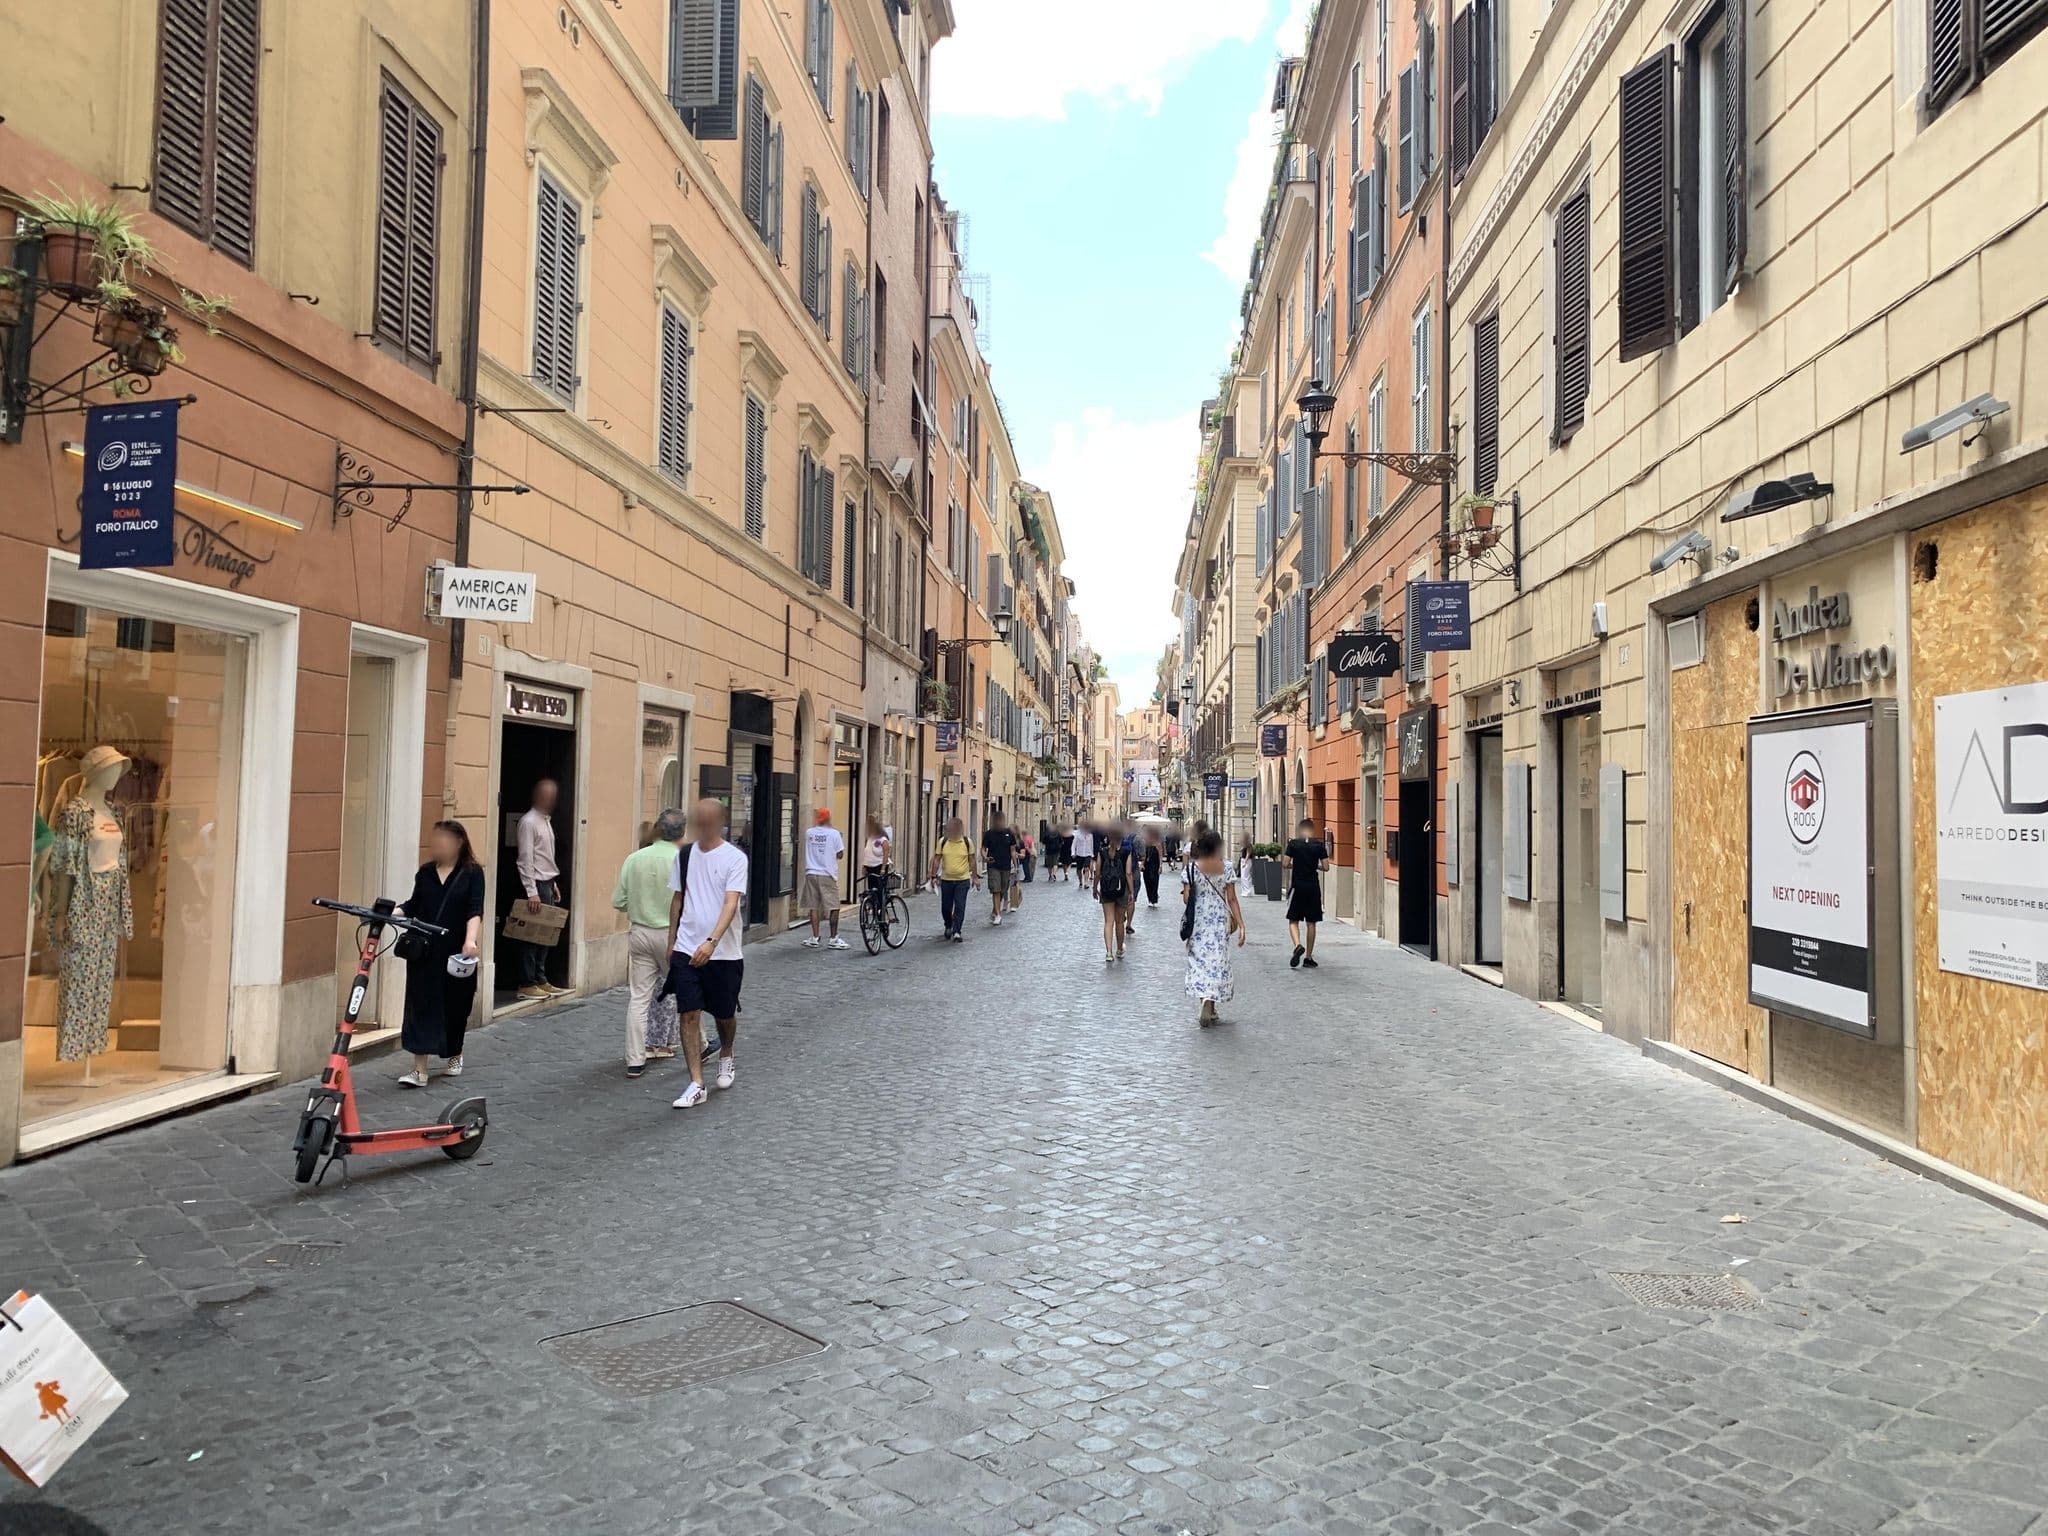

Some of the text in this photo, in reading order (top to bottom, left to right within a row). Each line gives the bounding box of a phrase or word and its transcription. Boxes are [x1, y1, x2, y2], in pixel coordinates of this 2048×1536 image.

[122, 480, 152, 490] LUGLIO
[112, 508, 142, 519] ROMA
[96, 520, 159, 533] FORO ITALICO
[183, 521, 256, 590] Vintage
[449, 578, 528, 596] AMERICAN
[455, 595, 519, 613] VINTAGE
[1771, 585, 1852, 644] Andrea
[1774, 643, 1897, 699] De Marco
[1793, 811, 1817, 827] ROOS
[1772, 885, 1841, 909] NEXT OPENING
[1961, 893, 1983, 902] THINK
[1985, 896, 2018, 907] OUTSIDE
[2019, 899, 2037, 909] THE
